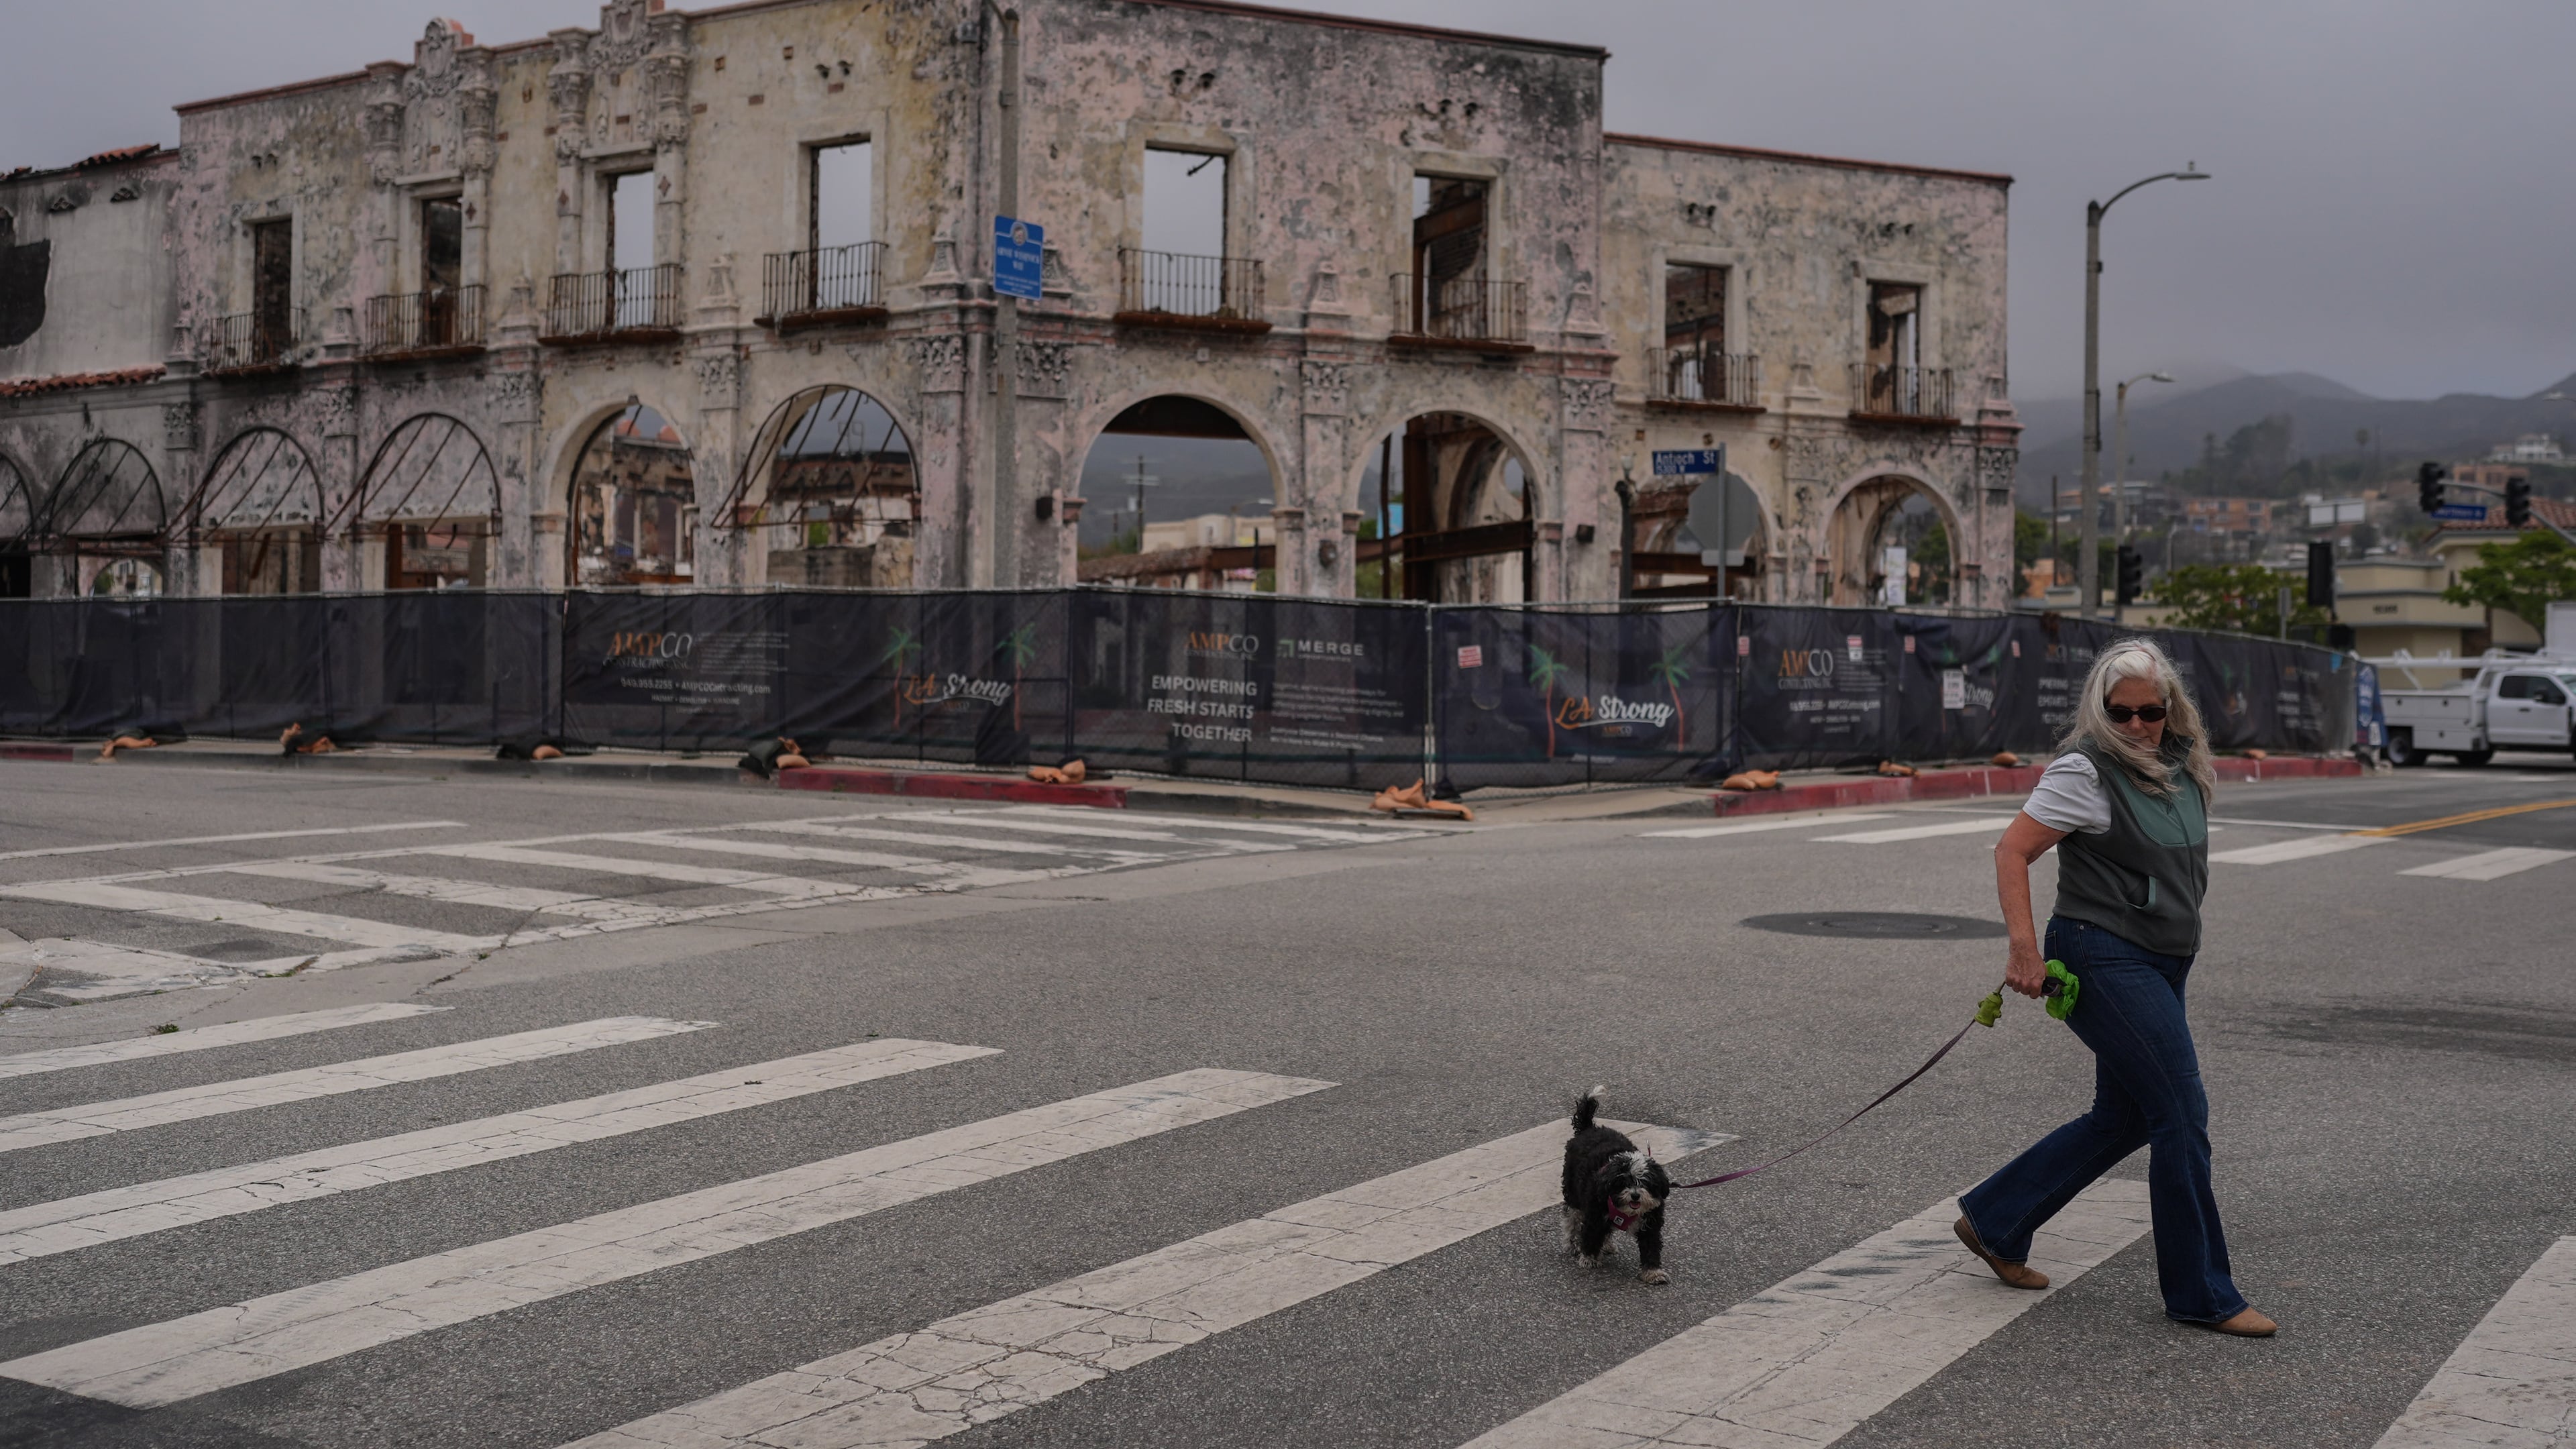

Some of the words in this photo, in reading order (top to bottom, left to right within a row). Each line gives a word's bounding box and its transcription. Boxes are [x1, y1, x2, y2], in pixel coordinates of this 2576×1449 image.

[1656, 452, 1695, 466] Antioch
[1703, 451, 1714, 464] St
[606, 631, 692, 659] AMPCO
[1184, 631, 1259, 653] AMPCO
[1297, 639, 1364, 656] MERGE
[1152, 675, 1258, 696] EMPOWERING
[1147, 698, 1195, 716] FRESH
[1199, 701, 1255, 720] STARTS
[1599, 694, 1674, 727] Strong
[1172, 722, 1253, 743] TOGETHER
